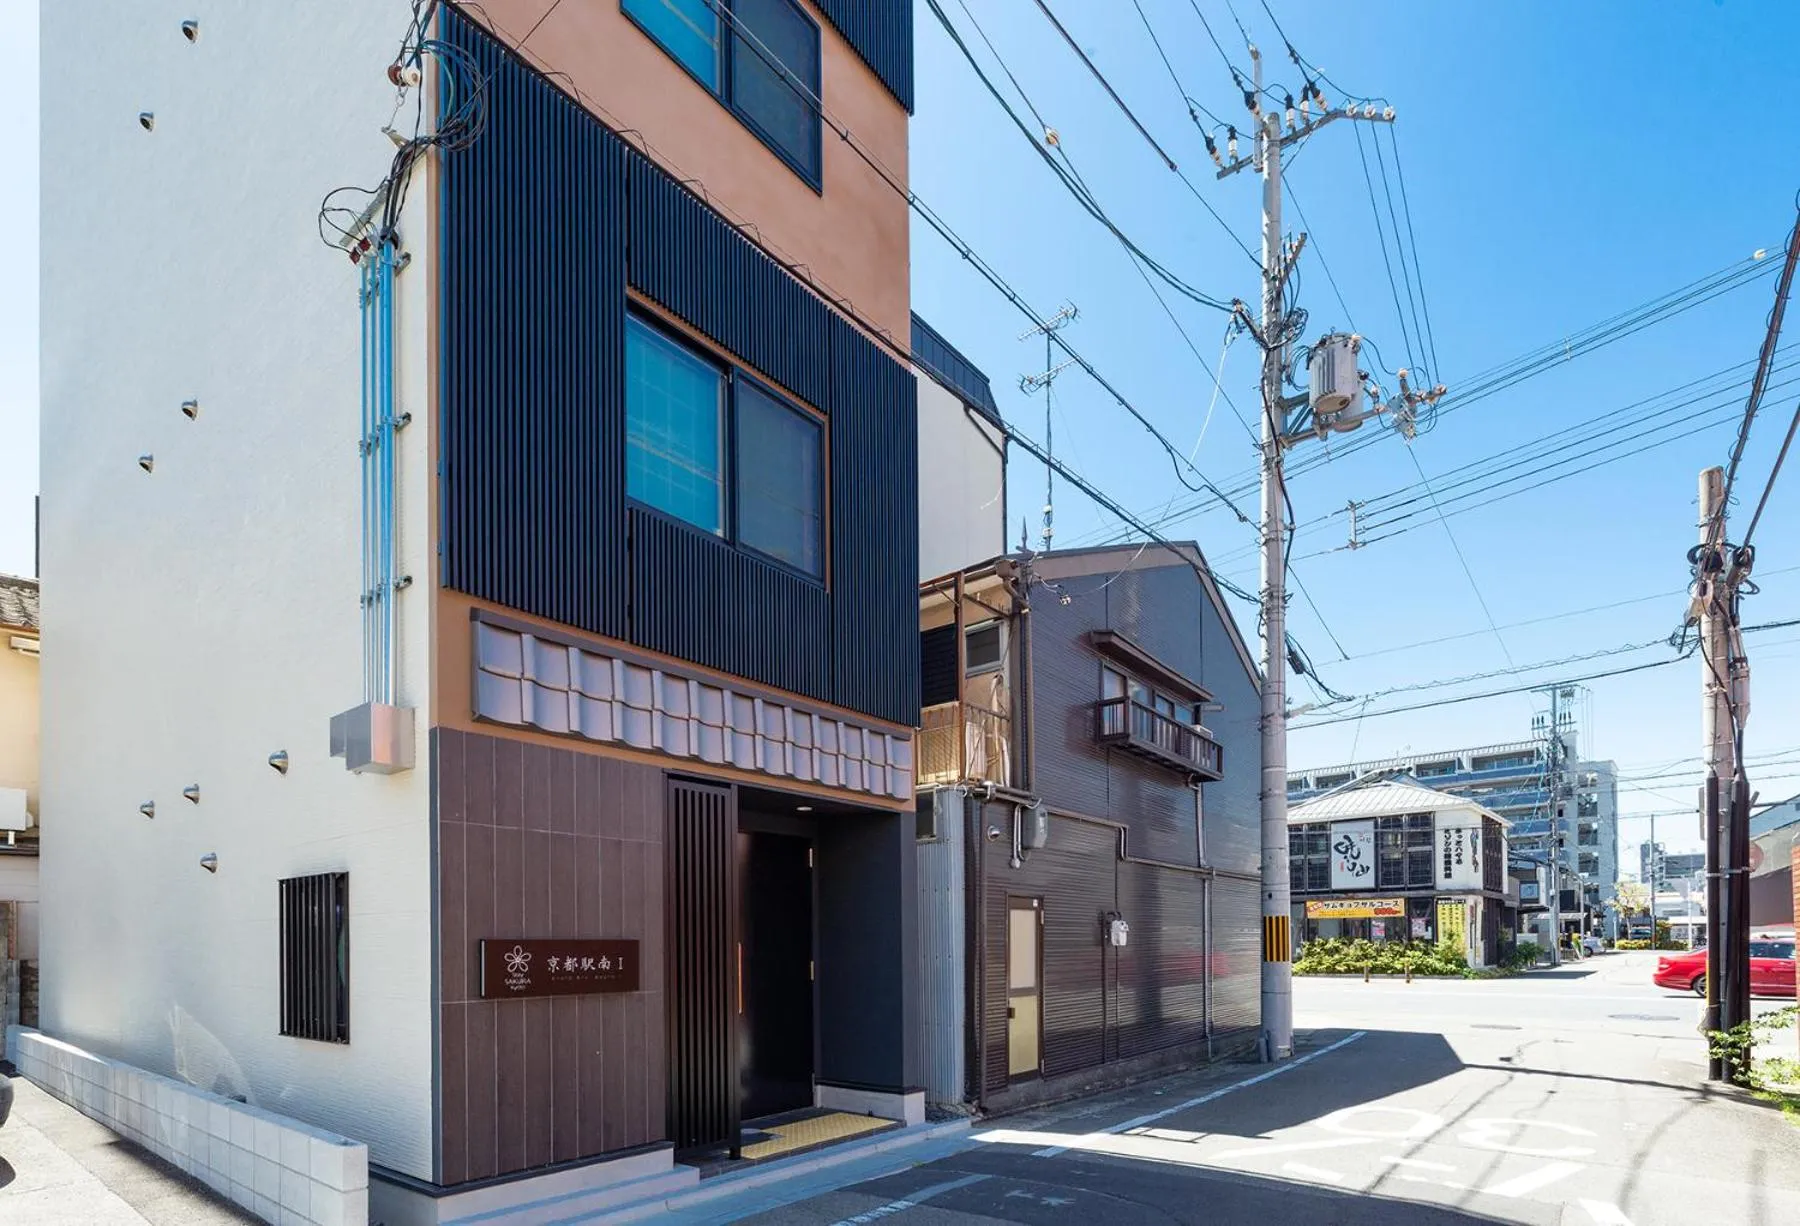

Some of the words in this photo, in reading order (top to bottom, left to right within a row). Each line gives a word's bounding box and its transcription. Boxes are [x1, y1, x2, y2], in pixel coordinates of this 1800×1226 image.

[547, 955, 611, 973] 京都駅南
[1316, 1108, 1598, 1156] 30
